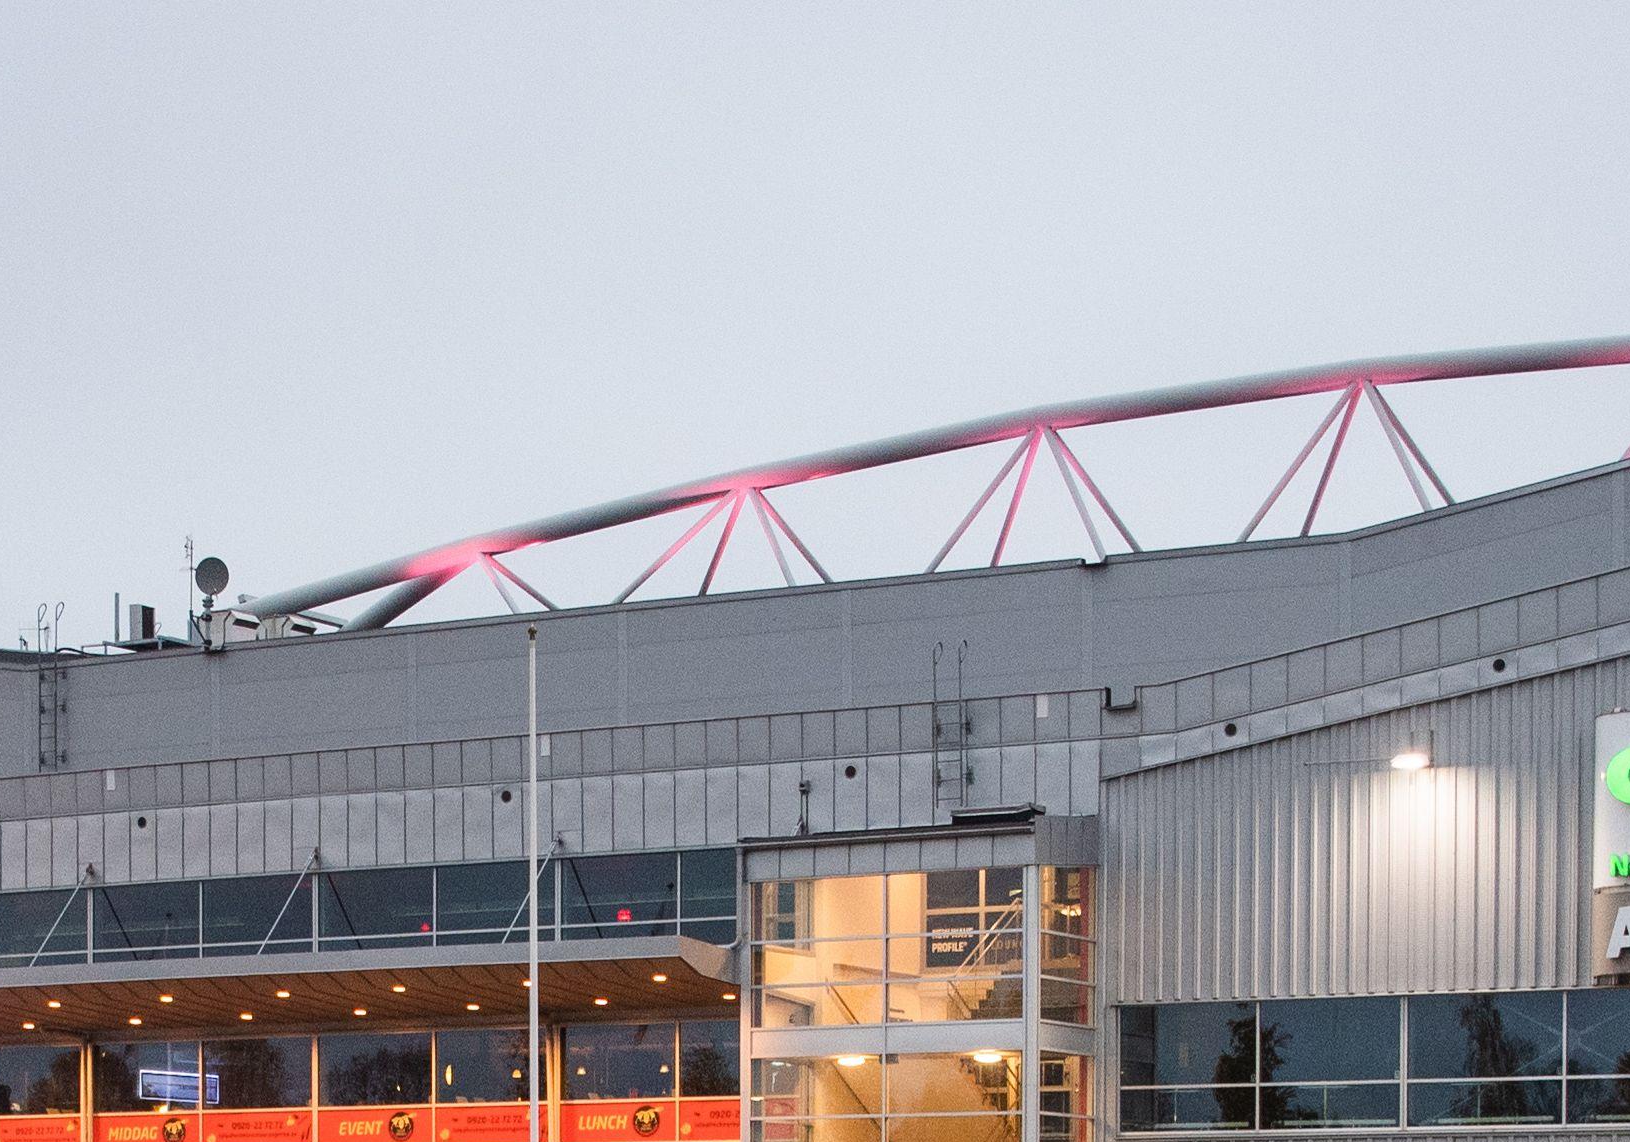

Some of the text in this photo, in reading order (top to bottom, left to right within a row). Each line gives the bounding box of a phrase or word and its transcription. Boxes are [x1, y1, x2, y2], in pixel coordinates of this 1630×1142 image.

[338, 1120, 383, 1136] EVENT
[578, 1115, 627, 1130] LUNCH
[108, 1126, 158, 1141] MIDDAG
